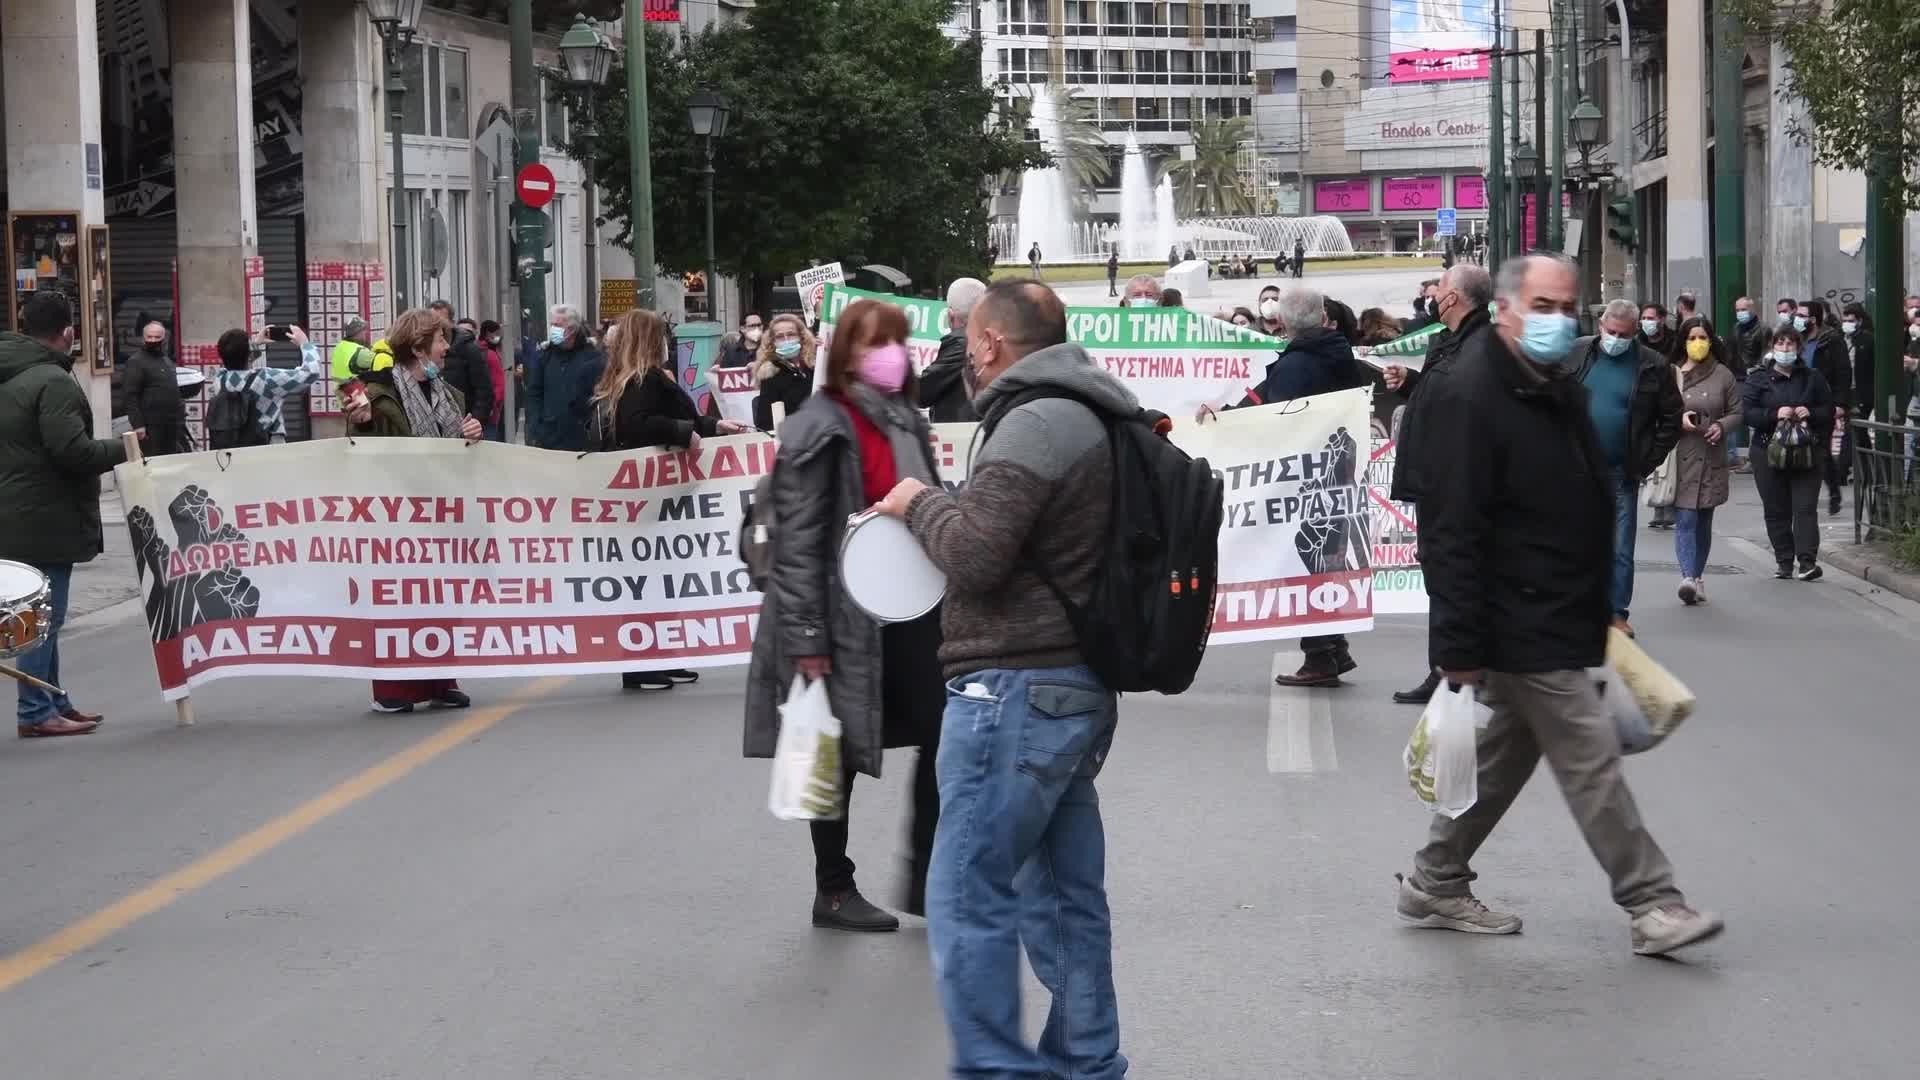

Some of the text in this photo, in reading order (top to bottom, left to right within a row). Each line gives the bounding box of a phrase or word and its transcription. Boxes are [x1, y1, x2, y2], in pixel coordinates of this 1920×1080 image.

[1443, 54, 1479, 71] FREE
[1382, 121, 1431, 138] Hondos
[1128, 313, 1179, 343] ΤΗΝ
[1104, 356, 1251, 379] ΣΥΣΤΗΜΑ ΥΓΕΙΑΣ
[235, 496, 465, 529] ΕΝΙΣΧΥΣΗ
[477, 497, 557, 523] ΤΟΥ
[571, 498, 648, 523] ΕΣΥ
[658, 492, 725, 522] ΜΕ
[168, 530, 734, 579] ΔΩΡΕΑΝ ΔΙΑΓΝΩΣΤΙΚΑ ΤΕΣΤ ΓΙΑ ΟΛΟΥΣ
[371, 577, 553, 606] ΕΠΙΤΑΞΗ
[564, 576, 648, 603] ΤΟΥ
[182, 624, 338, 669] ΑΔΕΔΥ
[349, 640, 363, 648] -
[374, 624, 578, 659] ΠΟΕΔΗΝ
[591, 636, 605, 645] -
